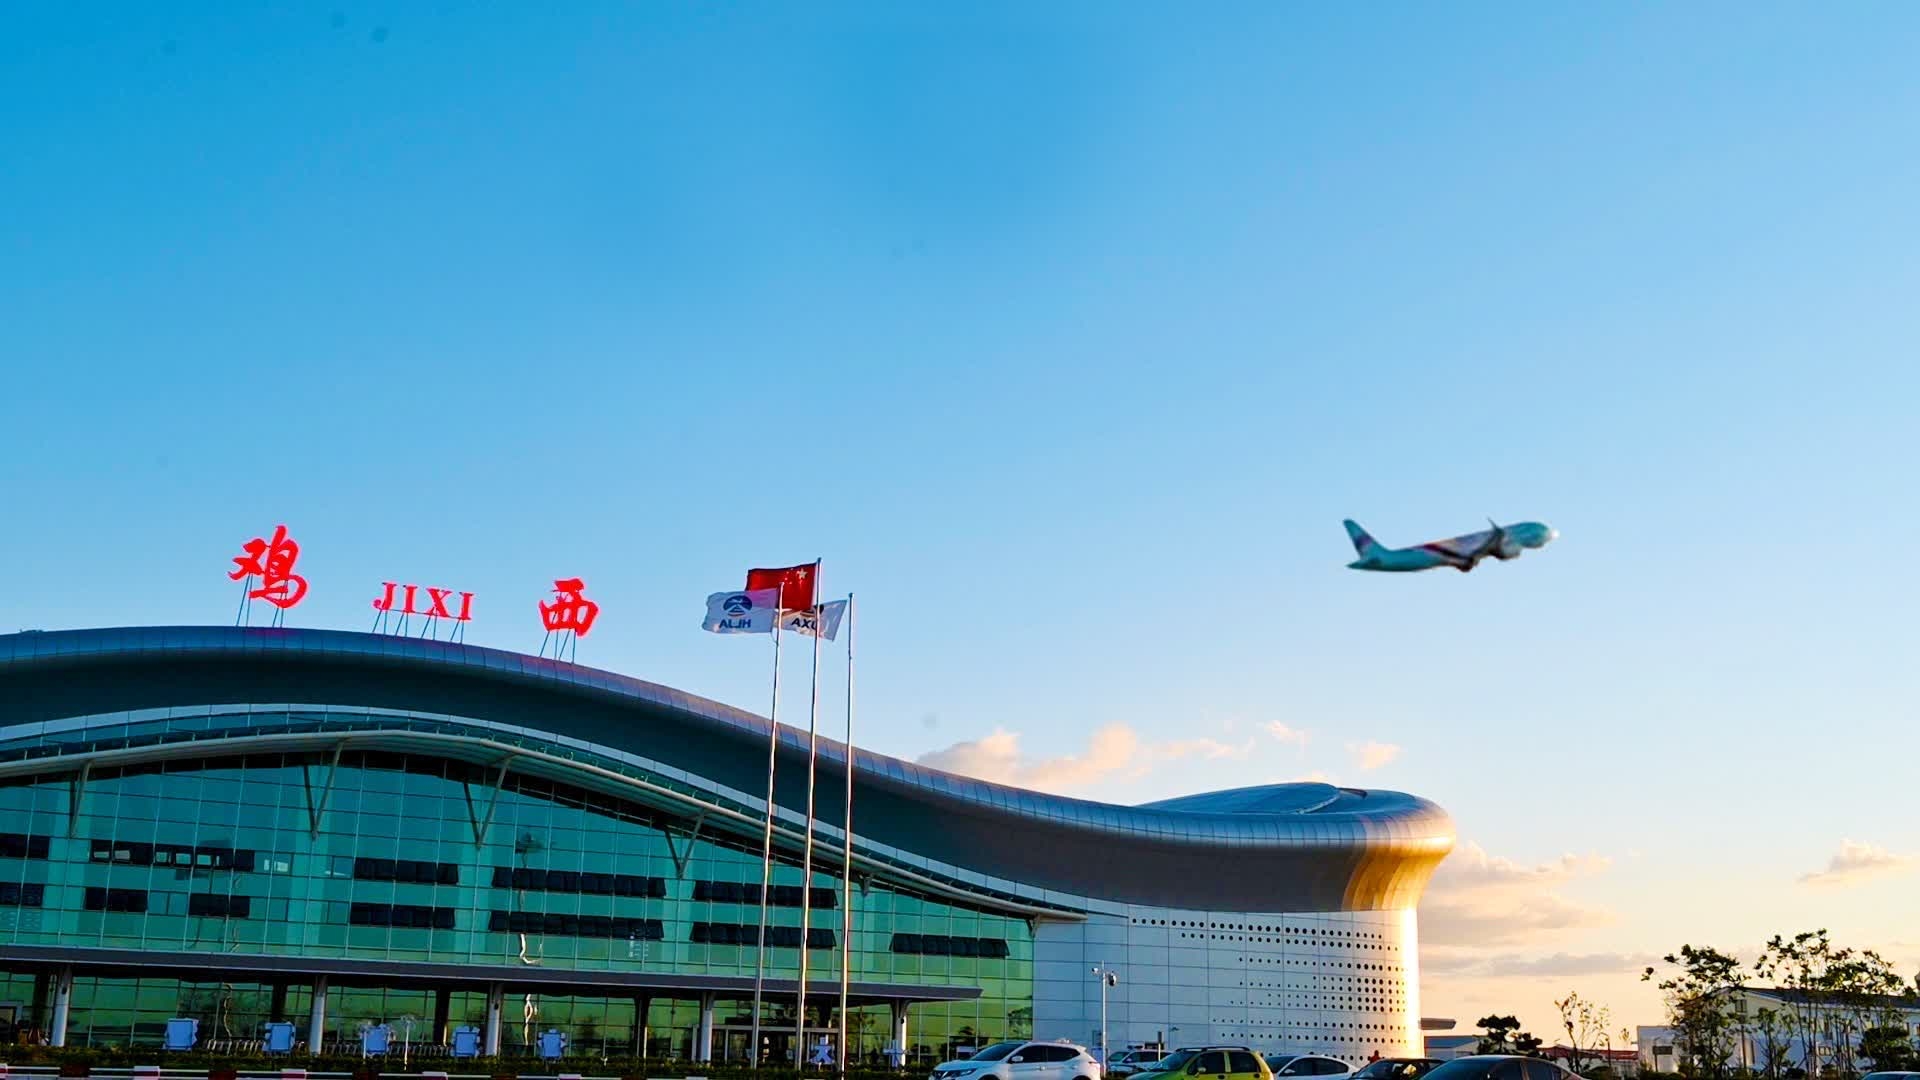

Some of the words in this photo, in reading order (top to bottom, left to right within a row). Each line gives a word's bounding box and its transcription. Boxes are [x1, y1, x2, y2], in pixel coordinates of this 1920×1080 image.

[228, 525, 308, 608] 鸡
[372, 582, 474, 621] JIXI
[539, 578, 599, 637] 西
